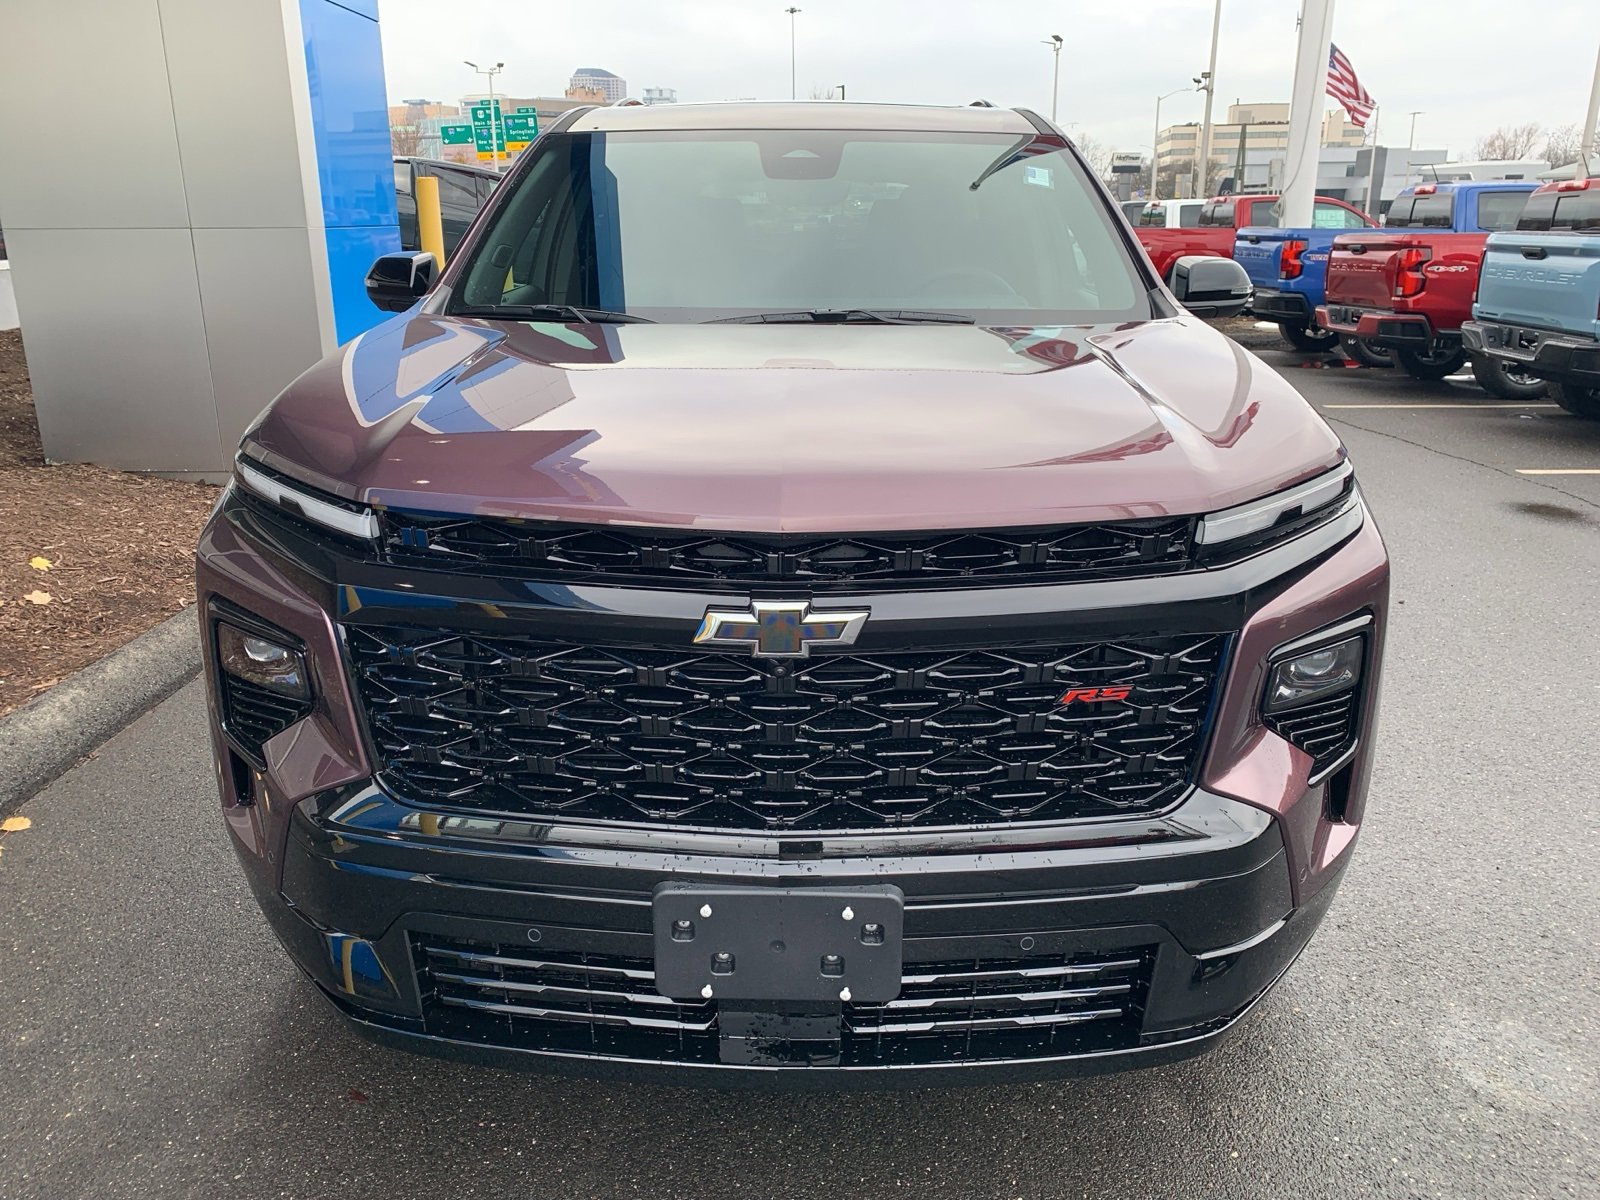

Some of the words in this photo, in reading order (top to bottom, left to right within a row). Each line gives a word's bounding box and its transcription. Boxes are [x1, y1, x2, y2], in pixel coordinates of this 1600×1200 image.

[1115, 154, 1141, 162] Hoffman
[1486, 267, 1583, 286] CHEVROLET
[1058, 684, 1134, 705] RS
